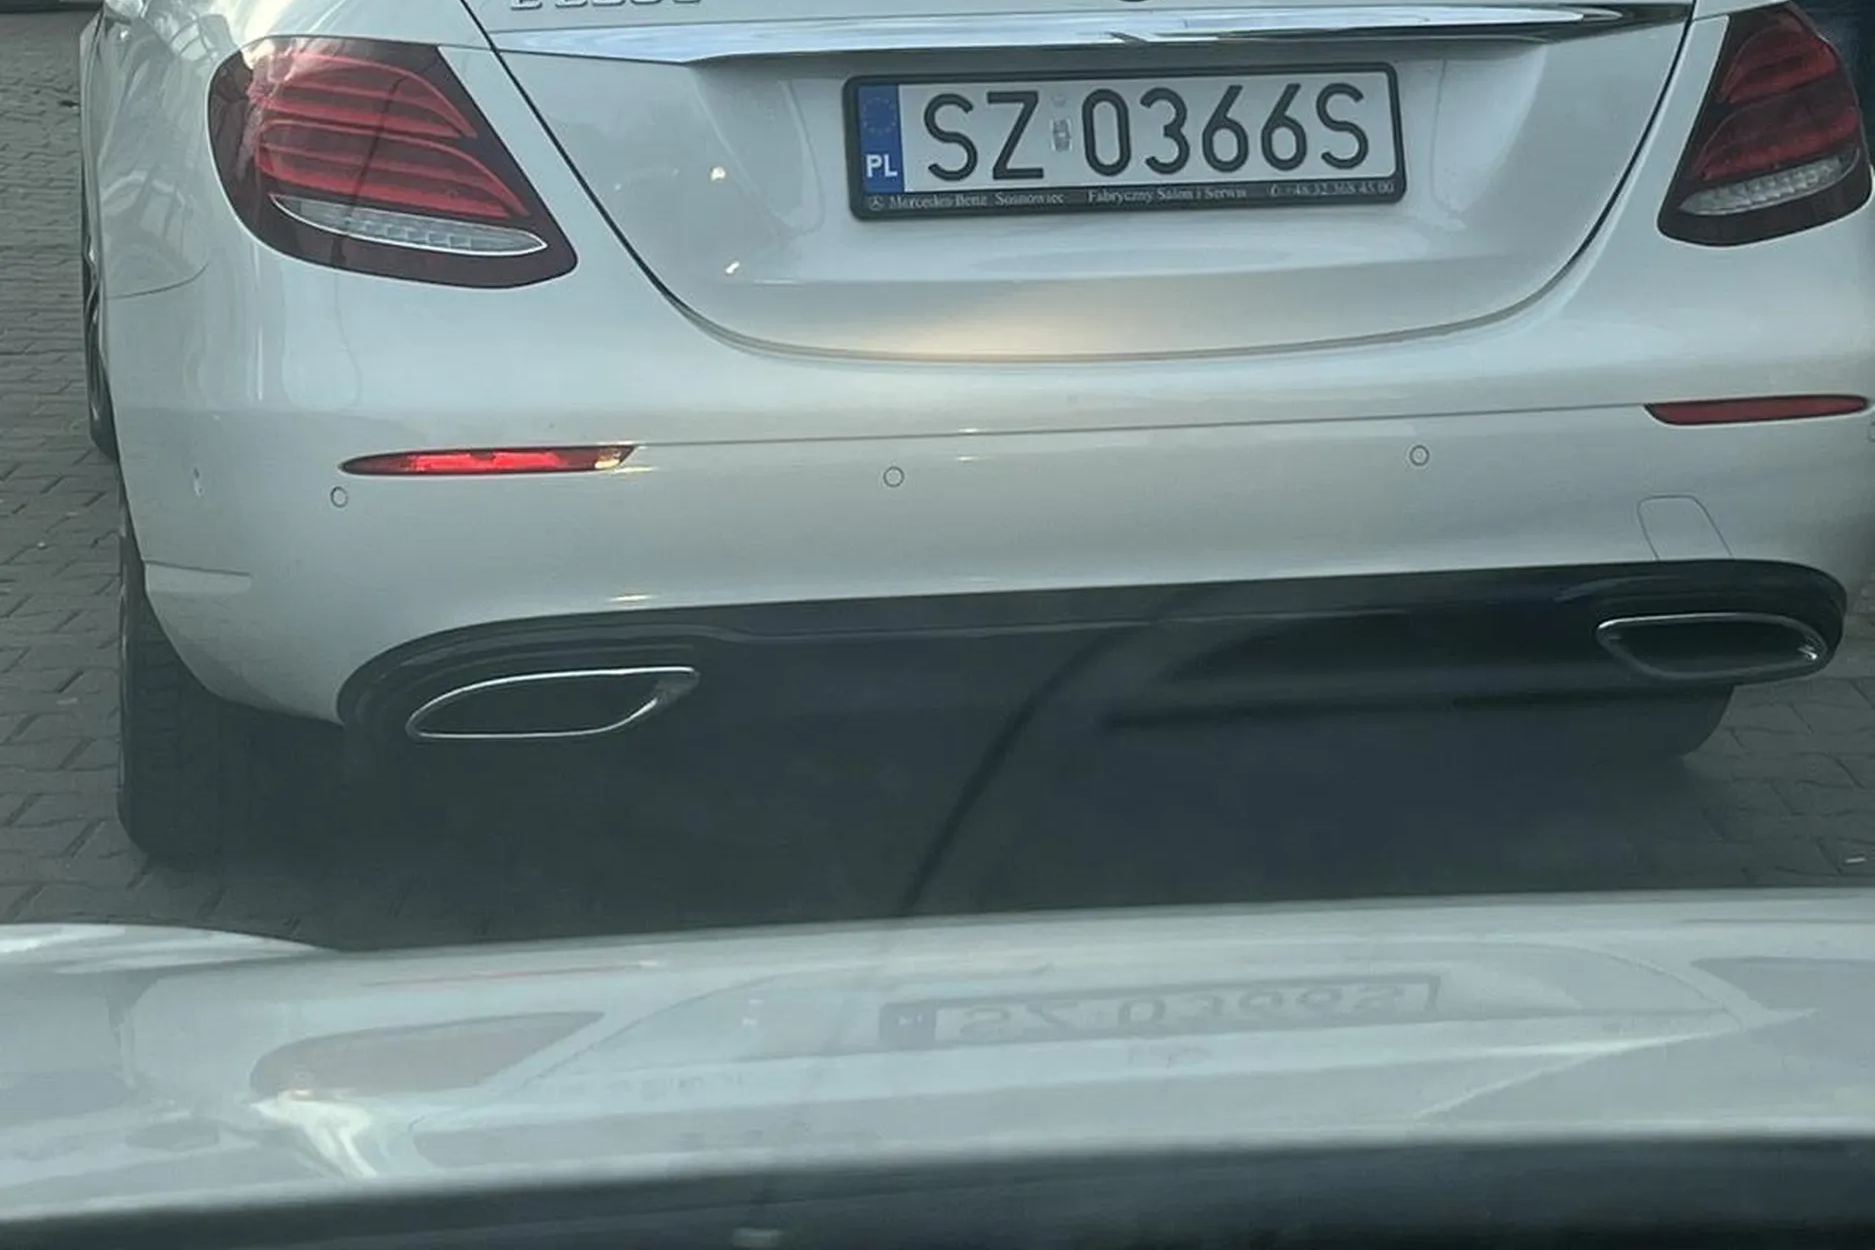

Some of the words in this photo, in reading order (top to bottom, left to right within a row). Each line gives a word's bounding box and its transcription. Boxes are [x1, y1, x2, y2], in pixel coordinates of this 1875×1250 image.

[924, 91, 1045, 181] SZ
[1081, 82, 1370, 177] 0366S
[865, 153, 899, 178] PL
[1088, 187, 1153, 205] Fabryczny
[1156, 185, 1196, 200] Salon
